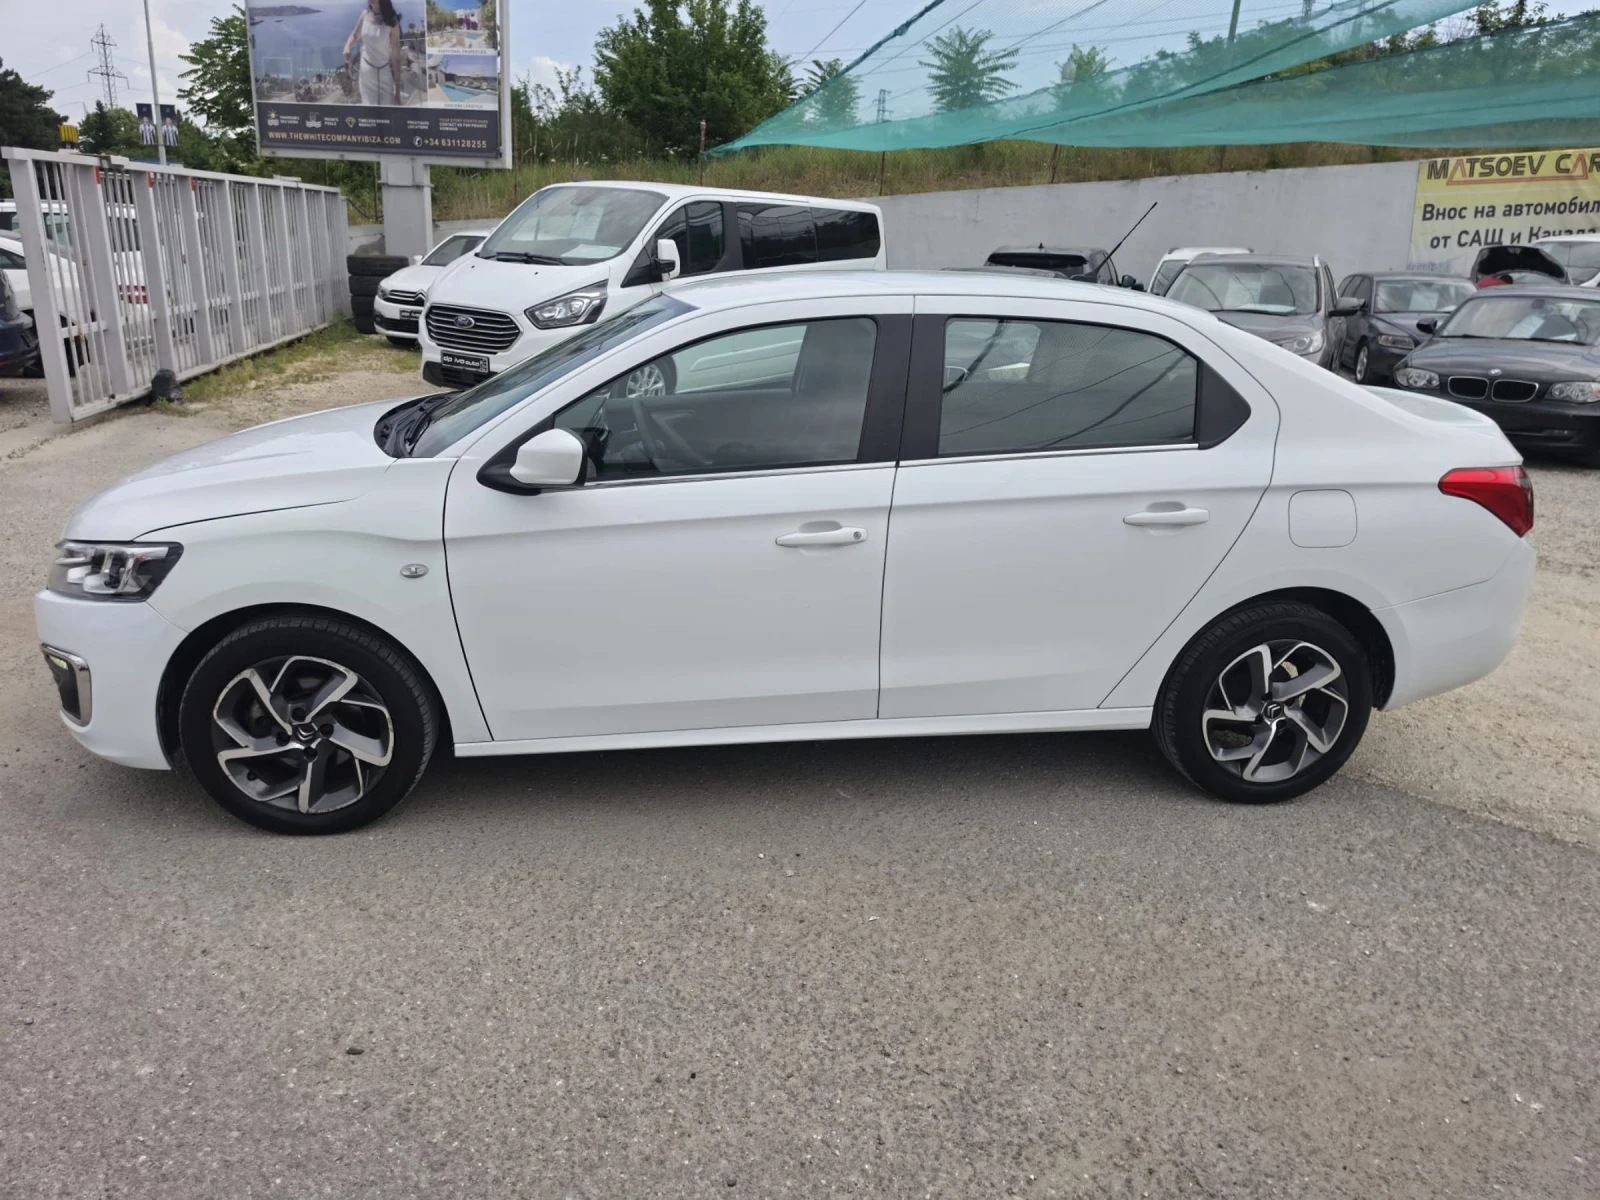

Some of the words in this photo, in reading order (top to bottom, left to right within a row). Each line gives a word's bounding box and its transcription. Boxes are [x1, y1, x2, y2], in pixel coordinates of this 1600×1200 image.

[268, 131, 401, 145] WWW.THEWHITECOMPANYIBIZA.COM
[424, 138, 440, 147] +34
[441, 138, 487, 149] 631128255
[1427, 155, 1546, 182] MATSOEV
[1555, 153, 1600, 178] CAR
[1422, 203, 1467, 221] Внос
[1474, 204, 1496, 218] на
[1502, 196, 1600, 217] автомобил
[1430, 235, 1451, 249] от
[1457, 228, 1504, 247] САЩ
[1510, 231, 1522, 244] и
